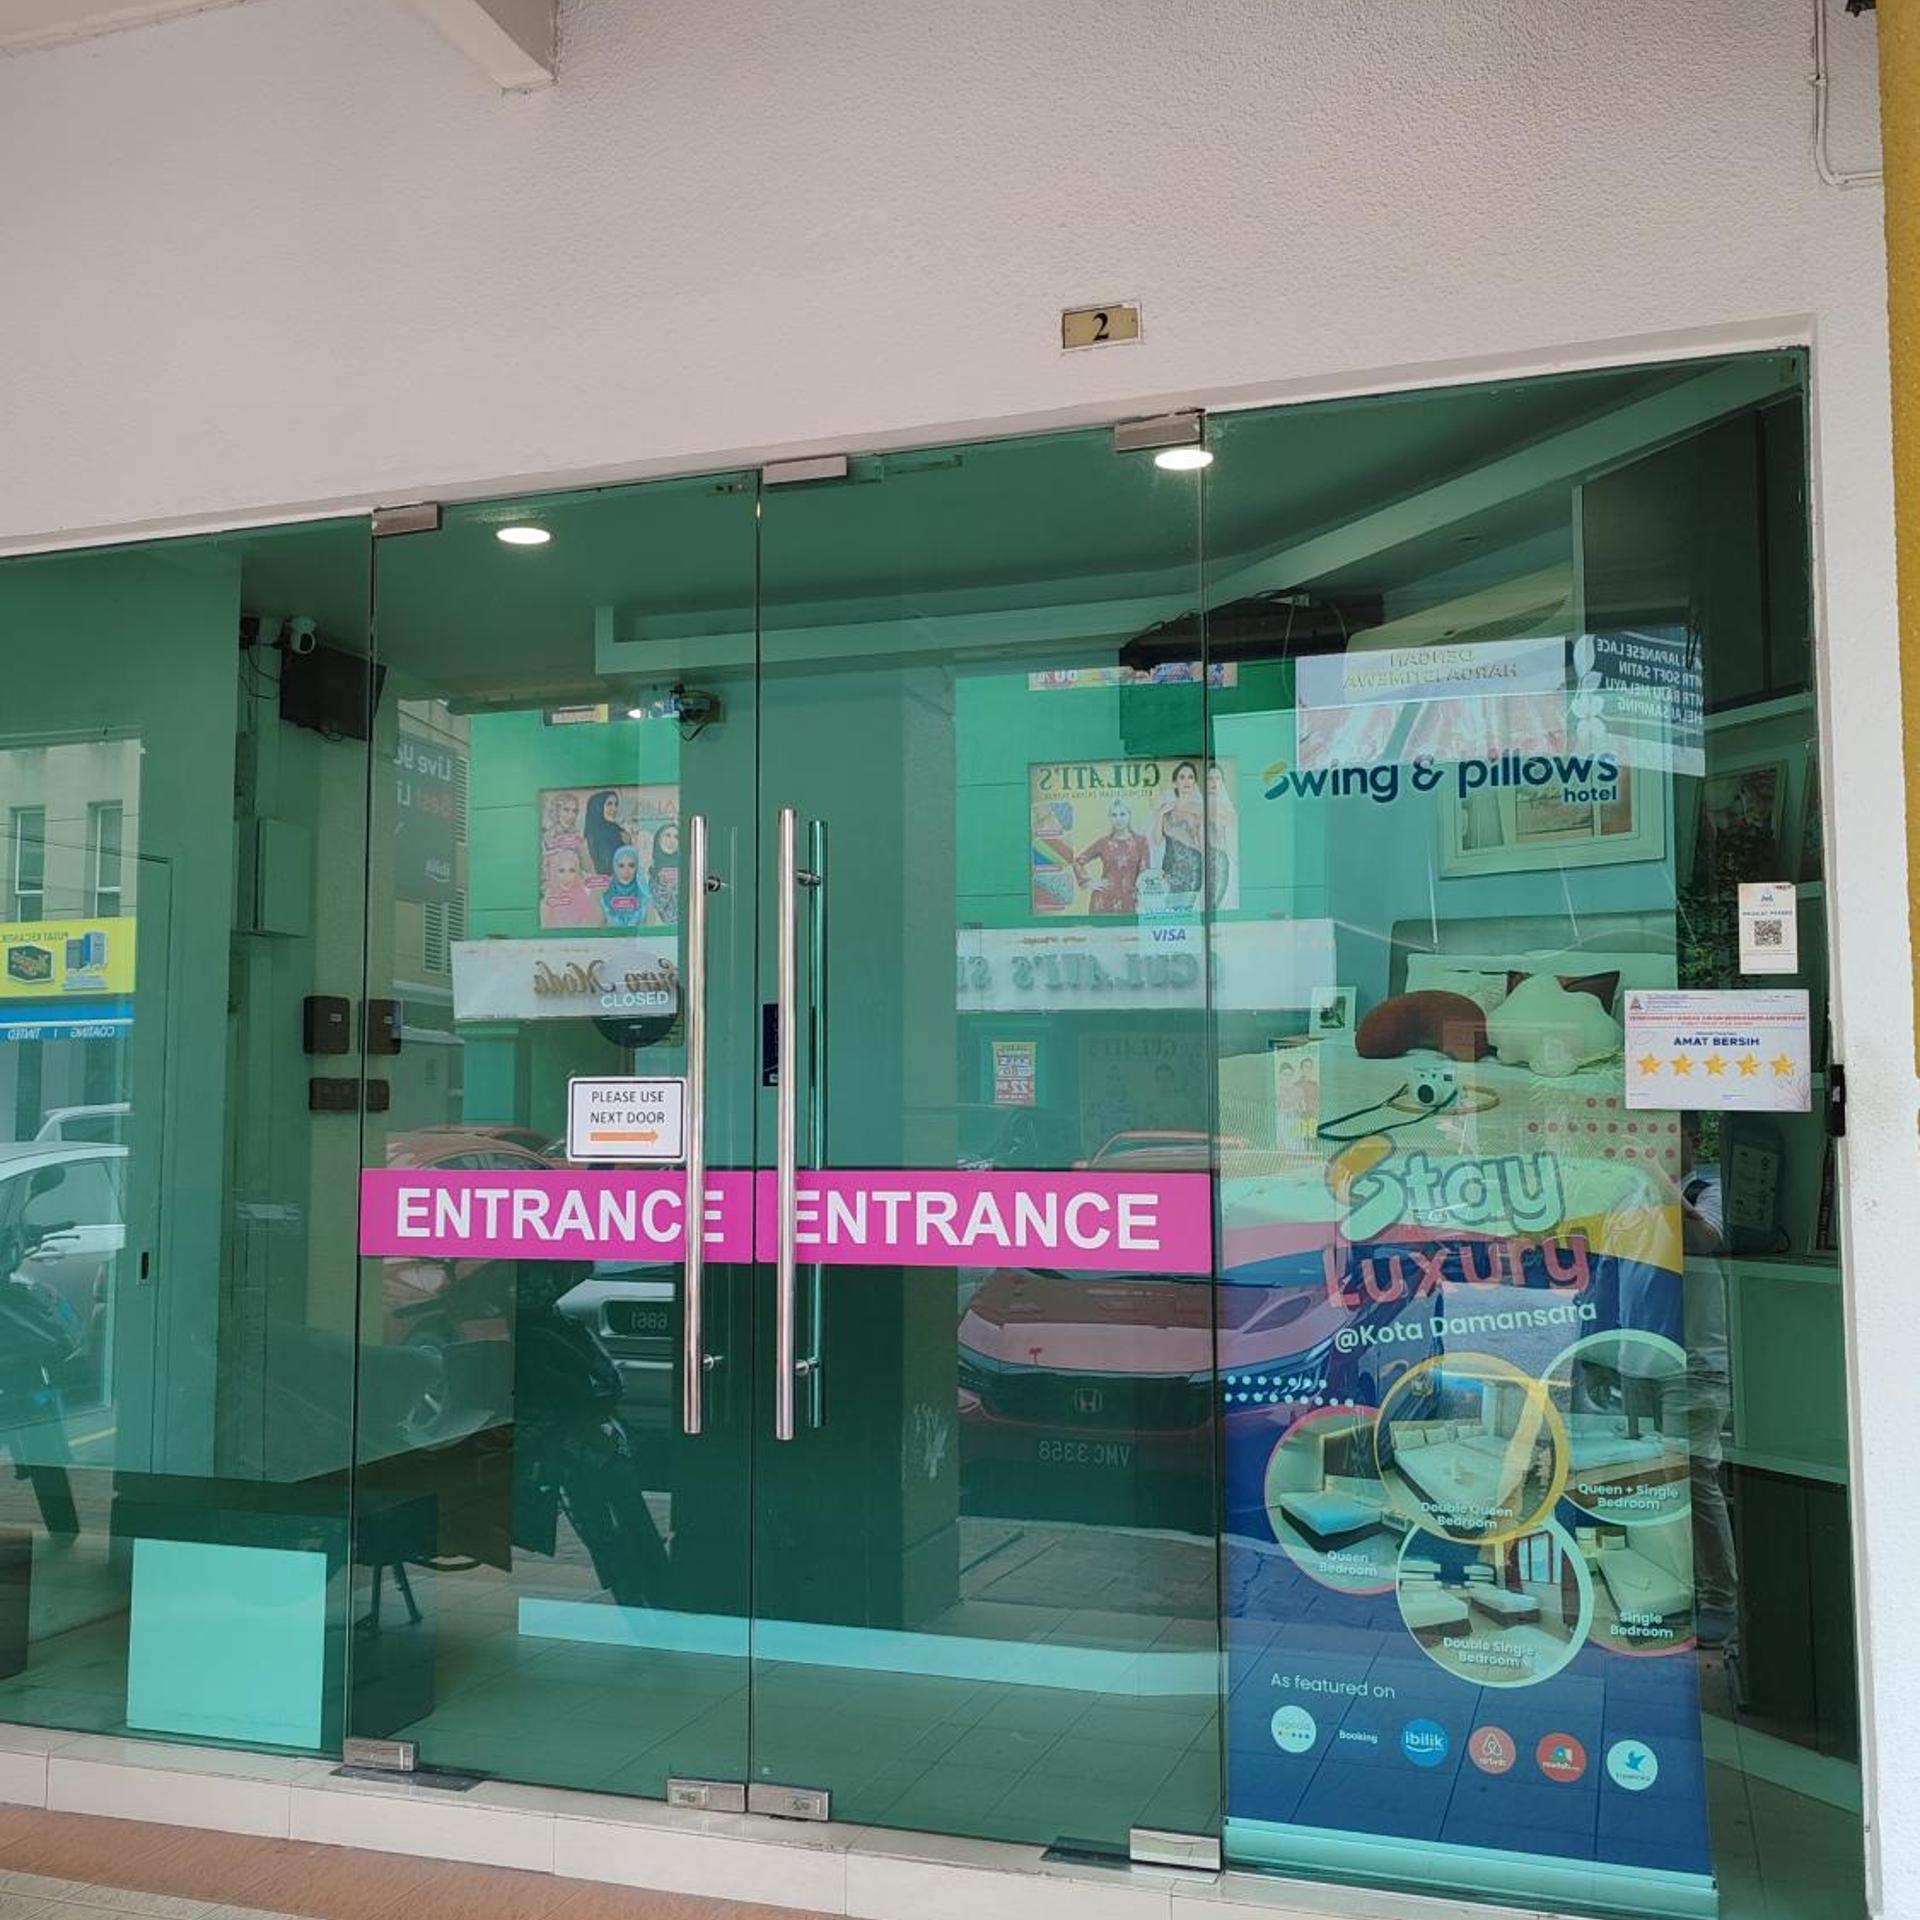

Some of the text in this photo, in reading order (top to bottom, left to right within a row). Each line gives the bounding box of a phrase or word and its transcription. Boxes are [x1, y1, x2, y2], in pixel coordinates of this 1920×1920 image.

[1092, 312, 1109, 342] 2
[1411, 753, 1444, 792] &
[1459, 747, 1620, 800] pillows
[1563, 784, 1618, 803] hotel
[1153, 929, 1187, 943] VISA
[600, 991, 669, 1008] CLOSED
[1673, 1036, 1760, 1047] AMAT BERSIH
[591, 1090, 665, 1103] PLEASE USE
[590, 1111, 665, 1124] NEXT DOOR
[1325, 1133, 1565, 1242] Stay
[396, 1187, 724, 1243] ENTRANCE
[795, 1189, 1160, 1251] ENTRANCE
[1321, 1230, 1591, 1309] Luxury
[1335, 1301, 1598, 1353] @Kota Damansara
[1577, 1483, 1623, 1497] Queen
[1636, 1483, 1680, 1501] Single
[1420, 1501, 1514, 1519] Double Queen
[1597, 1496, 1661, 1512] Bedroom
[1436, 1515, 1499, 1531] Bedroom
[1327, 1550, 1369, 1564] Queen
[1319, 1562, 1379, 1578] Bedroom
[1618, 1609, 1664, 1627] Single
[1609, 1623, 1675, 1640] Bedroom
[1442, 1635, 1536, 1658] Double Single
[1458, 1650, 1521, 1668] Bedroom
[1271, 1672, 1396, 1700] As featured on
[1339, 1729, 1379, 1745] Booking
[1405, 1730, 1446, 1748] ibilik
